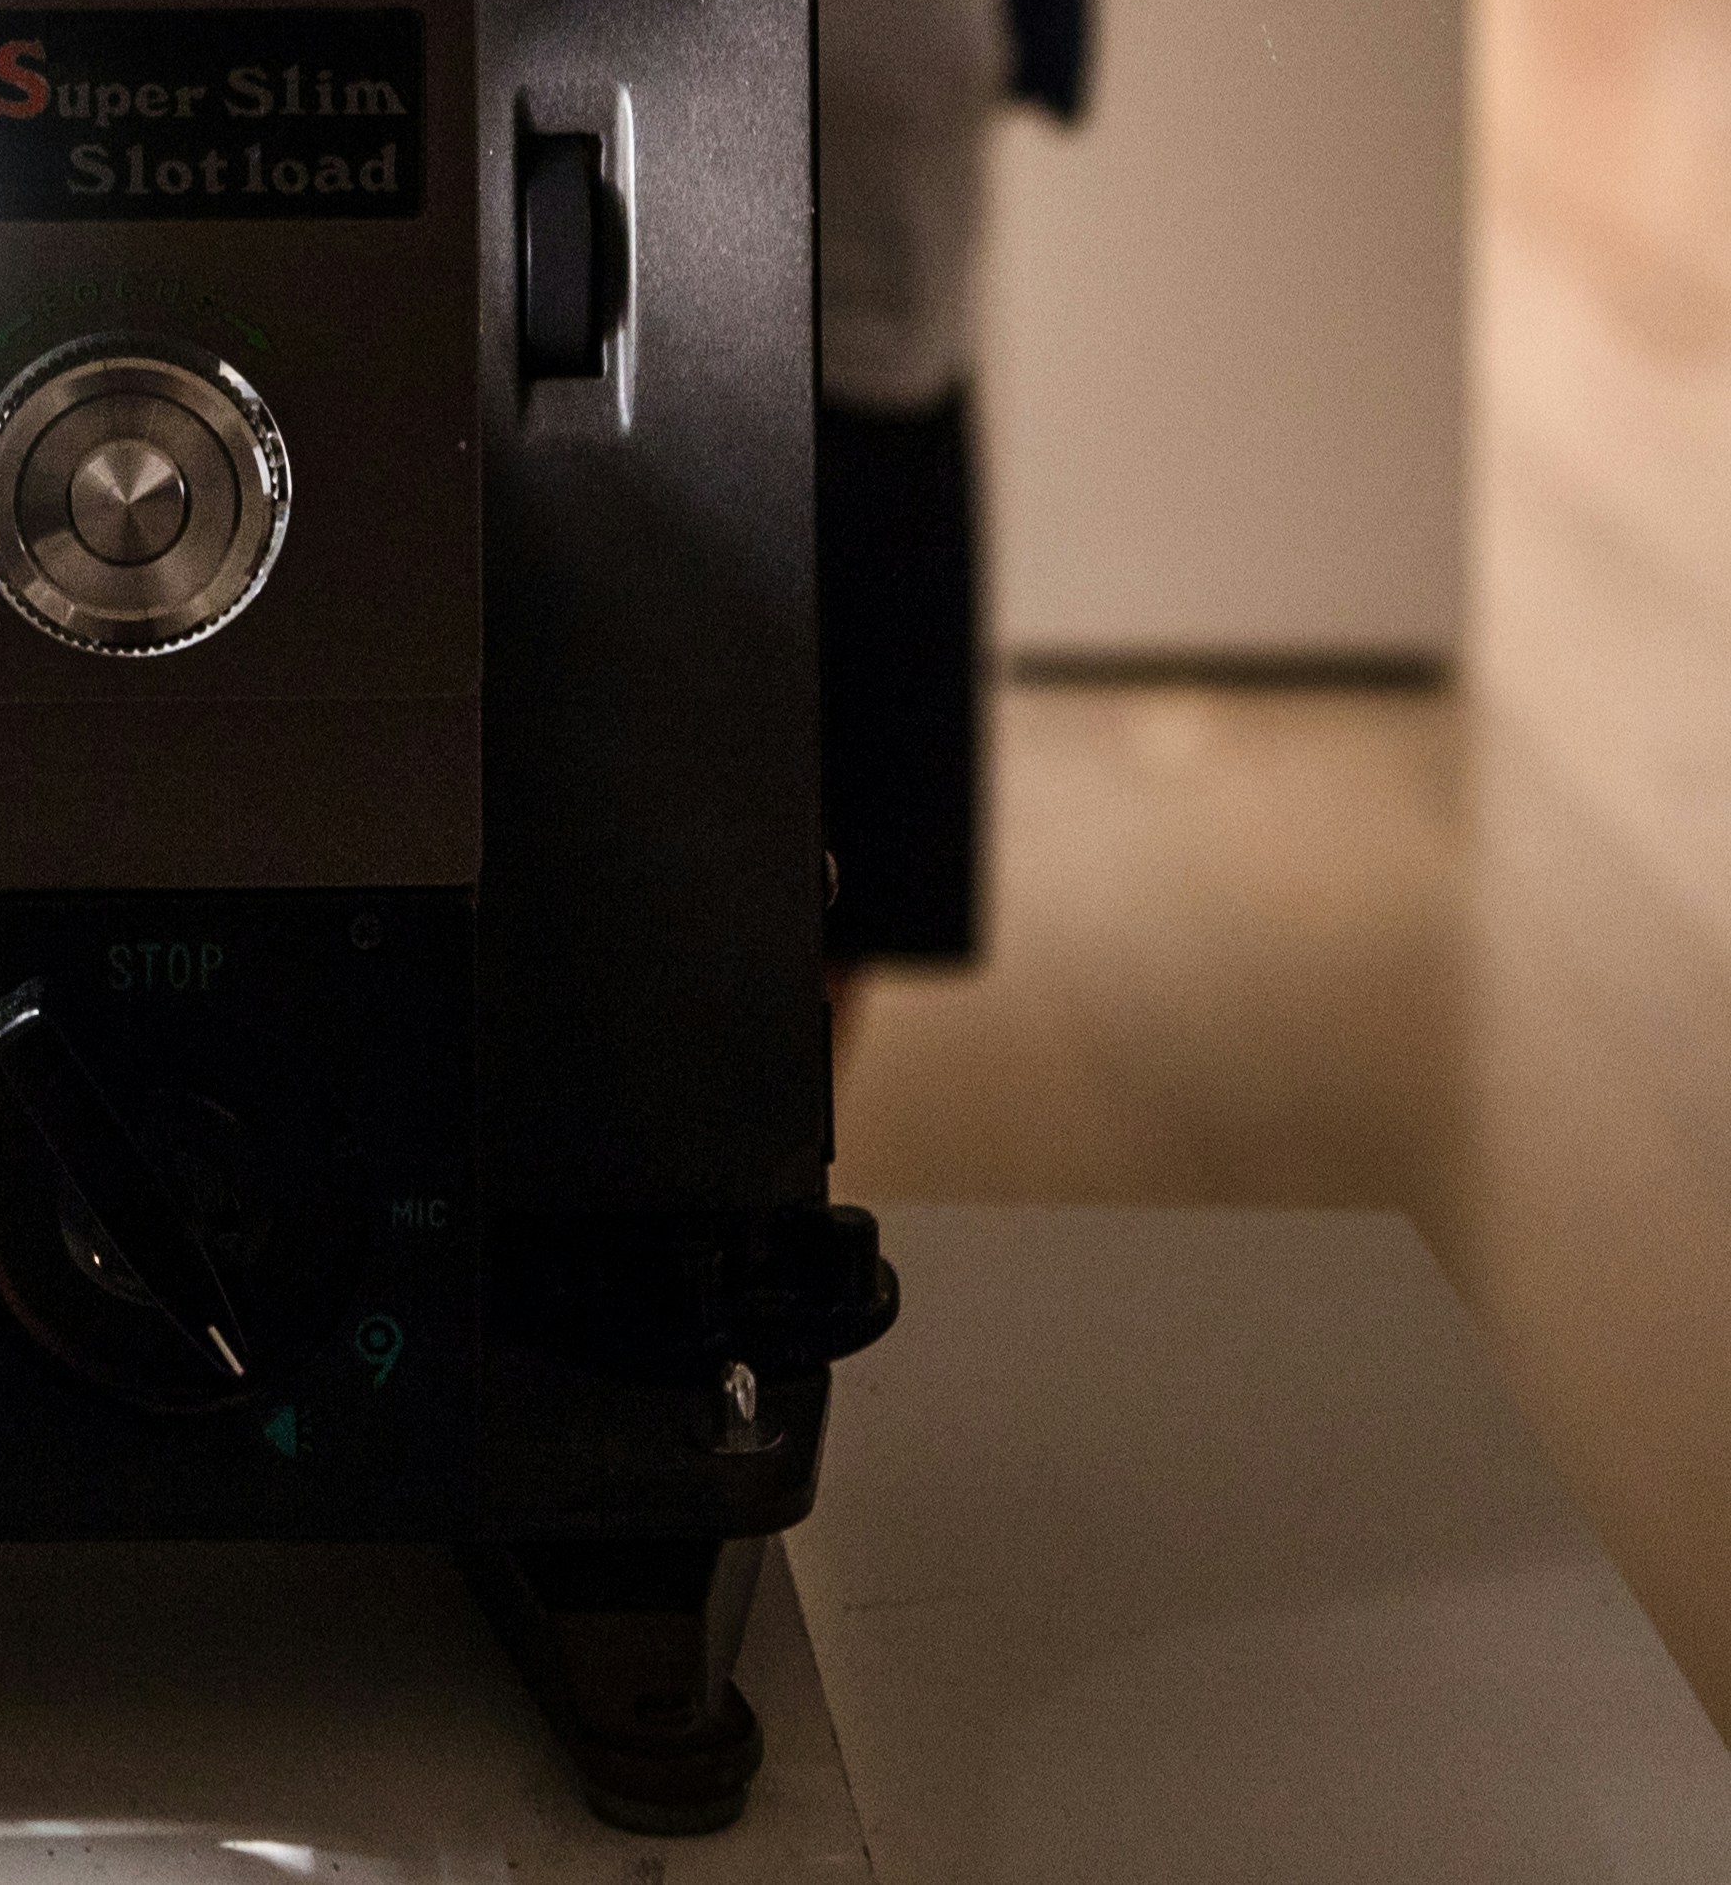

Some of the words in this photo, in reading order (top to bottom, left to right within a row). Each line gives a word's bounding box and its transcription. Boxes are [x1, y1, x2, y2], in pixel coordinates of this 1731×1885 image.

[224, 63, 408, 117] Slim
[108, 941, 224, 992] STOP
[391, 1198, 449, 1228] MIC
